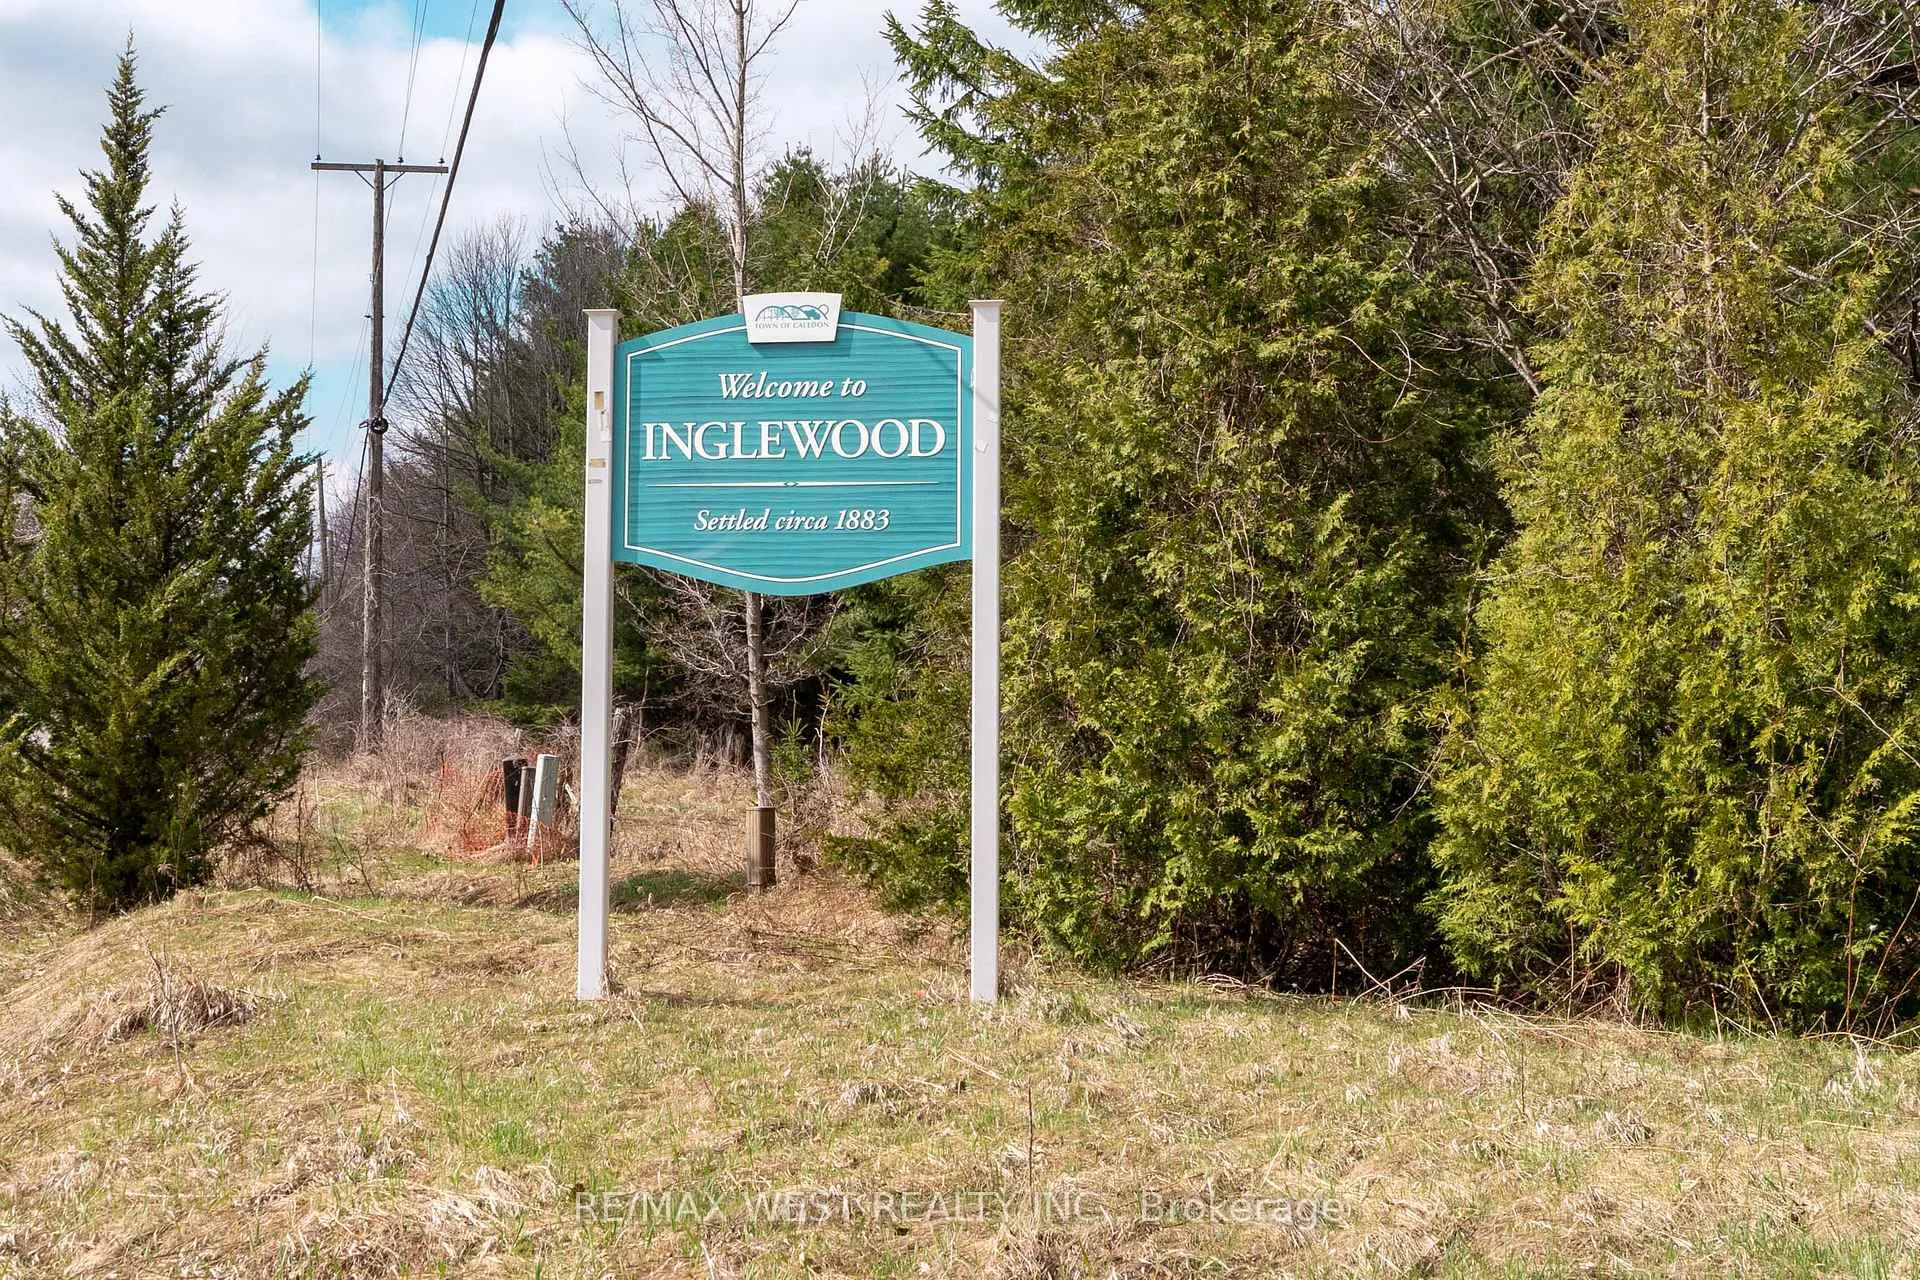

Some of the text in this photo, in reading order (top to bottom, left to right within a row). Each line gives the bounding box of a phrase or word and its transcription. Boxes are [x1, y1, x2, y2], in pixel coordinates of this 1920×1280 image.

[719, 372, 868, 399] Welcome to
[642, 419, 946, 460] INGLEWOOD
[694, 508, 890, 531] Settled circa 1883
